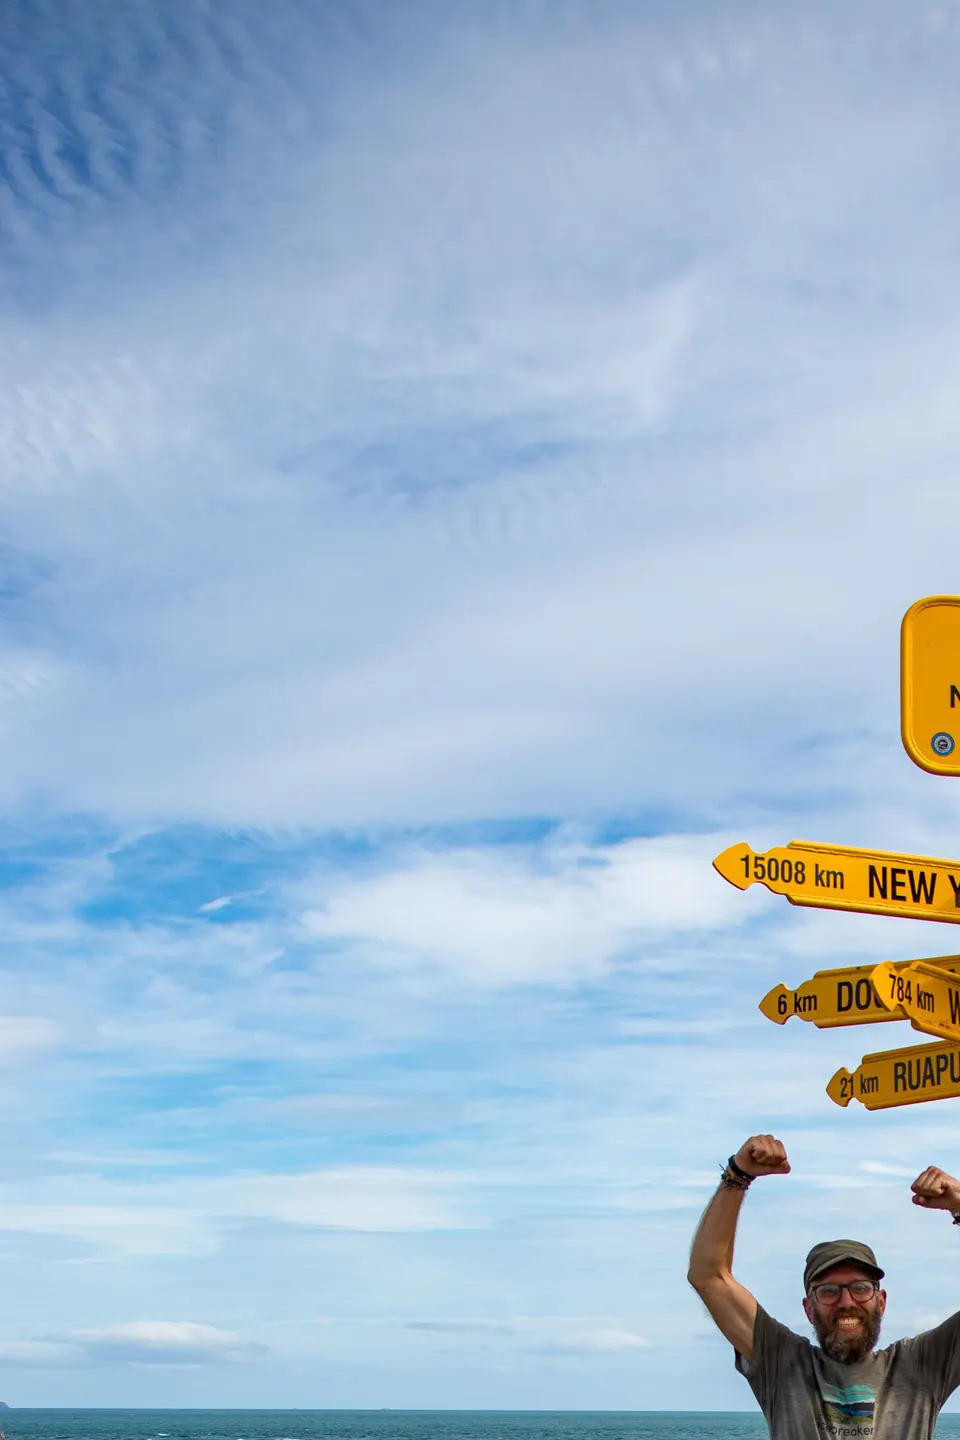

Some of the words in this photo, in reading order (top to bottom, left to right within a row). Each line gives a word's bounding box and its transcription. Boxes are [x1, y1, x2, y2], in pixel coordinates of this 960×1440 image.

[739, 853, 806, 885] 15008
[814, 863, 845, 890] km
[867, 864, 938, 906] NEW
[777, 993, 788, 1016] 6
[793, 991, 818, 1014] km
[888, 973, 913, 1006] 784
[916, 982, 936, 1013] km
[840, 1074, 854, 1098] 21
[860, 1073, 879, 1095] km
